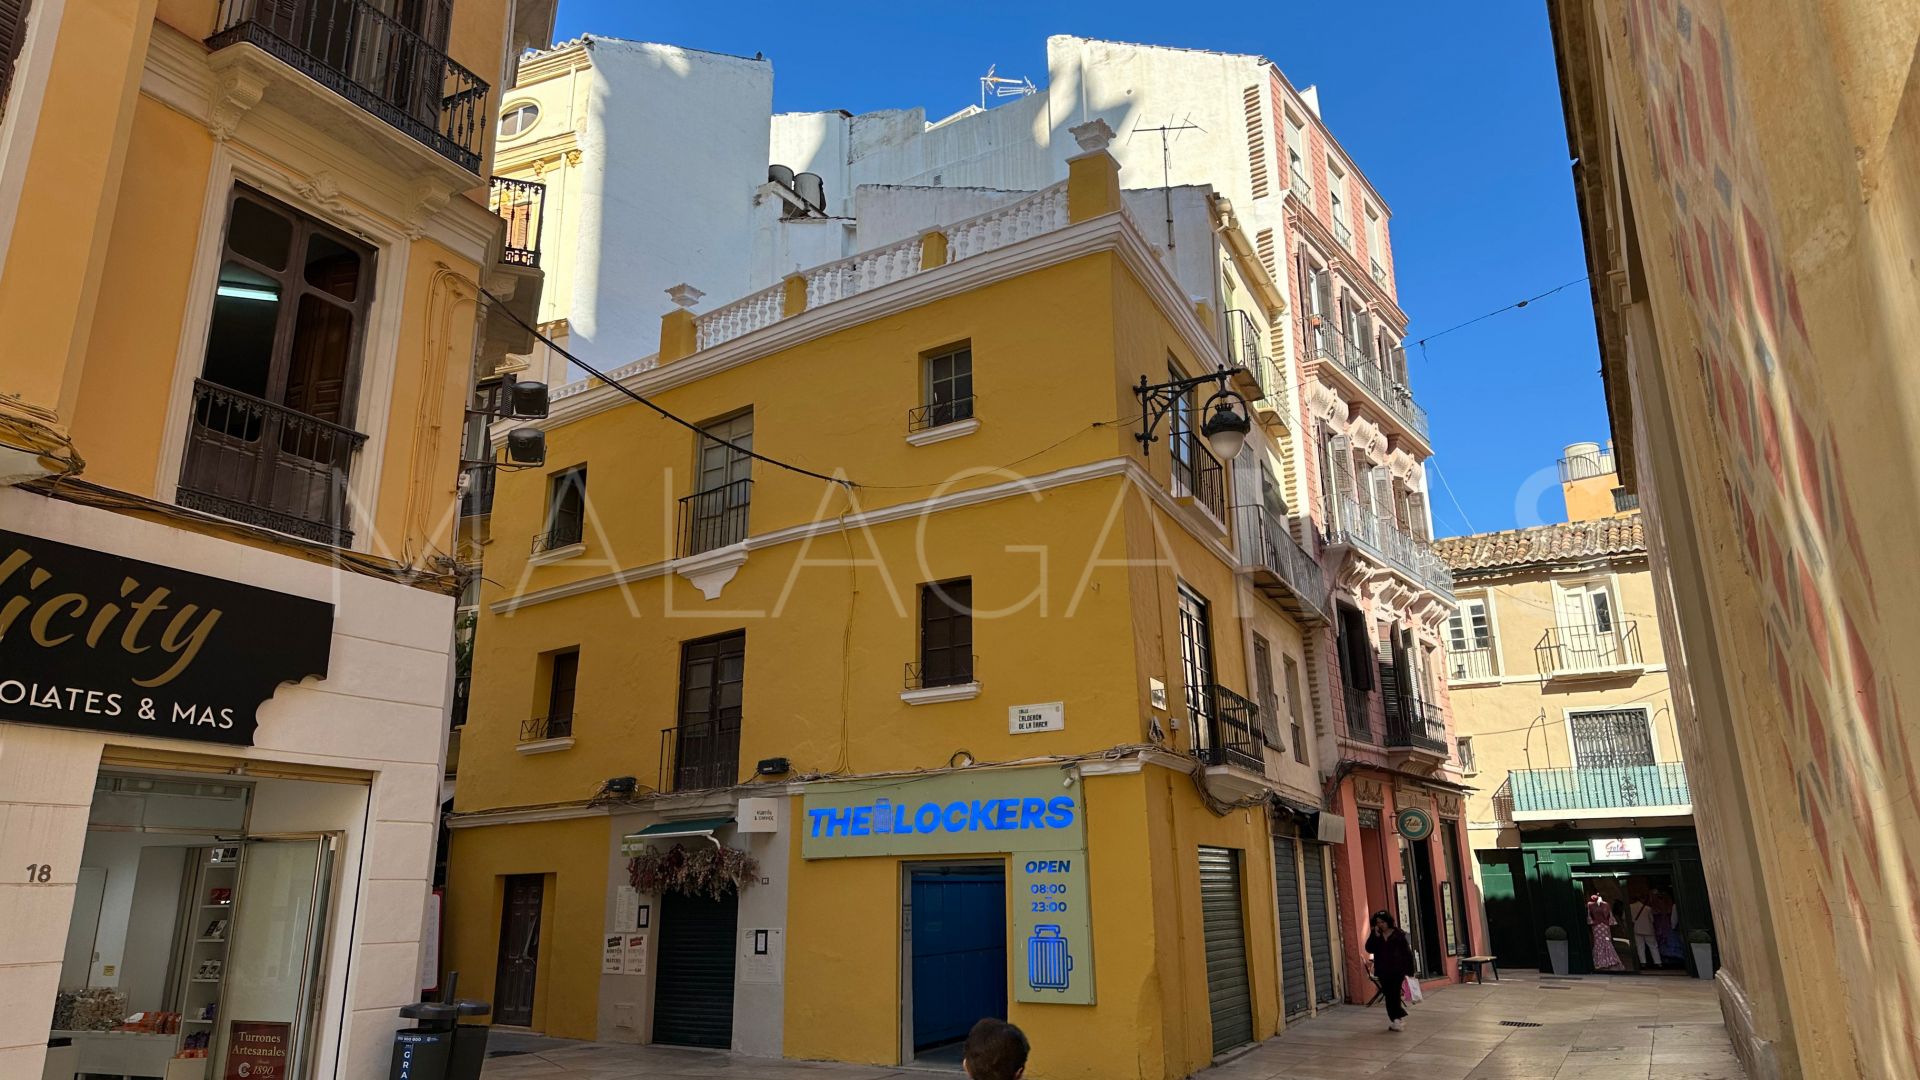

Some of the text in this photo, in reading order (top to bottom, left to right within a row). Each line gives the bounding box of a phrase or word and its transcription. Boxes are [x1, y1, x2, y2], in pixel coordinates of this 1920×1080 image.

[138, 697, 156, 721] &
[171, 702, 234, 729] MAS
[808, 795, 1075, 838] THE LOCKERS
[26, 863, 52, 883] 18
[1025, 860, 1071, 874] OPEN
[1031, 883, 1067, 894] 08:00
[1031, 901, 1067, 912] 23:00
[238, 1031, 281, 1043] Turrones
[231, 1044, 286, 1057] Artesanales
[252, 1065, 274, 1075] 1890
